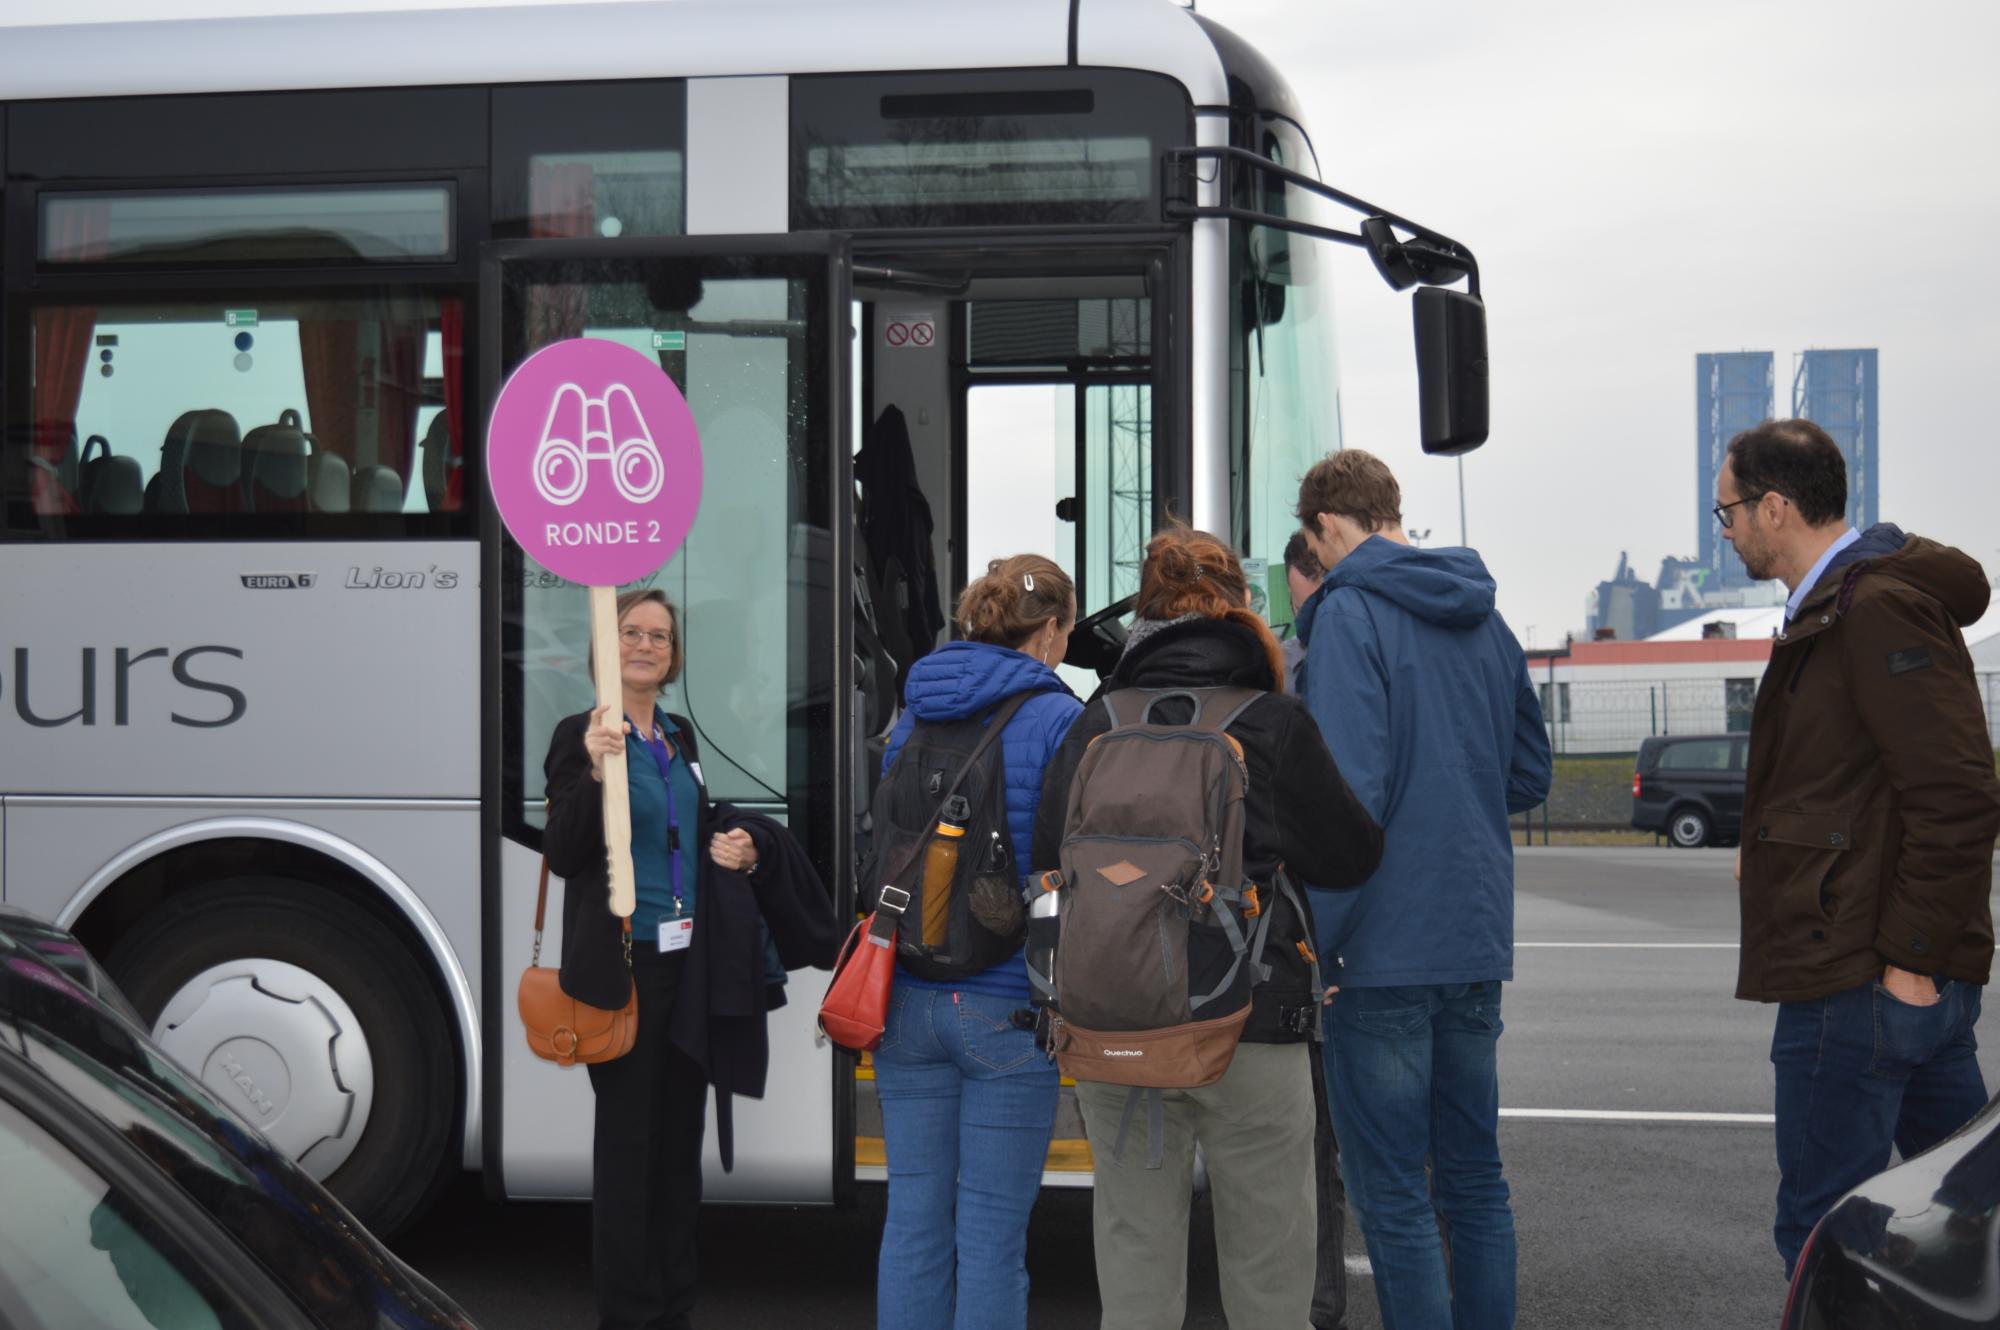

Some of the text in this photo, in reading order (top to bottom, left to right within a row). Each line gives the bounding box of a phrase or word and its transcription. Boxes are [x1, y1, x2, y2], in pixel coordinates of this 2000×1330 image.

[545, 520, 661, 546] RONDE 2
[246, 574, 310, 588] EURO 6
[344, 564, 459, 589] Lion's
[0, 645, 248, 728] urs
[218, 1052, 273, 1116] MAN
